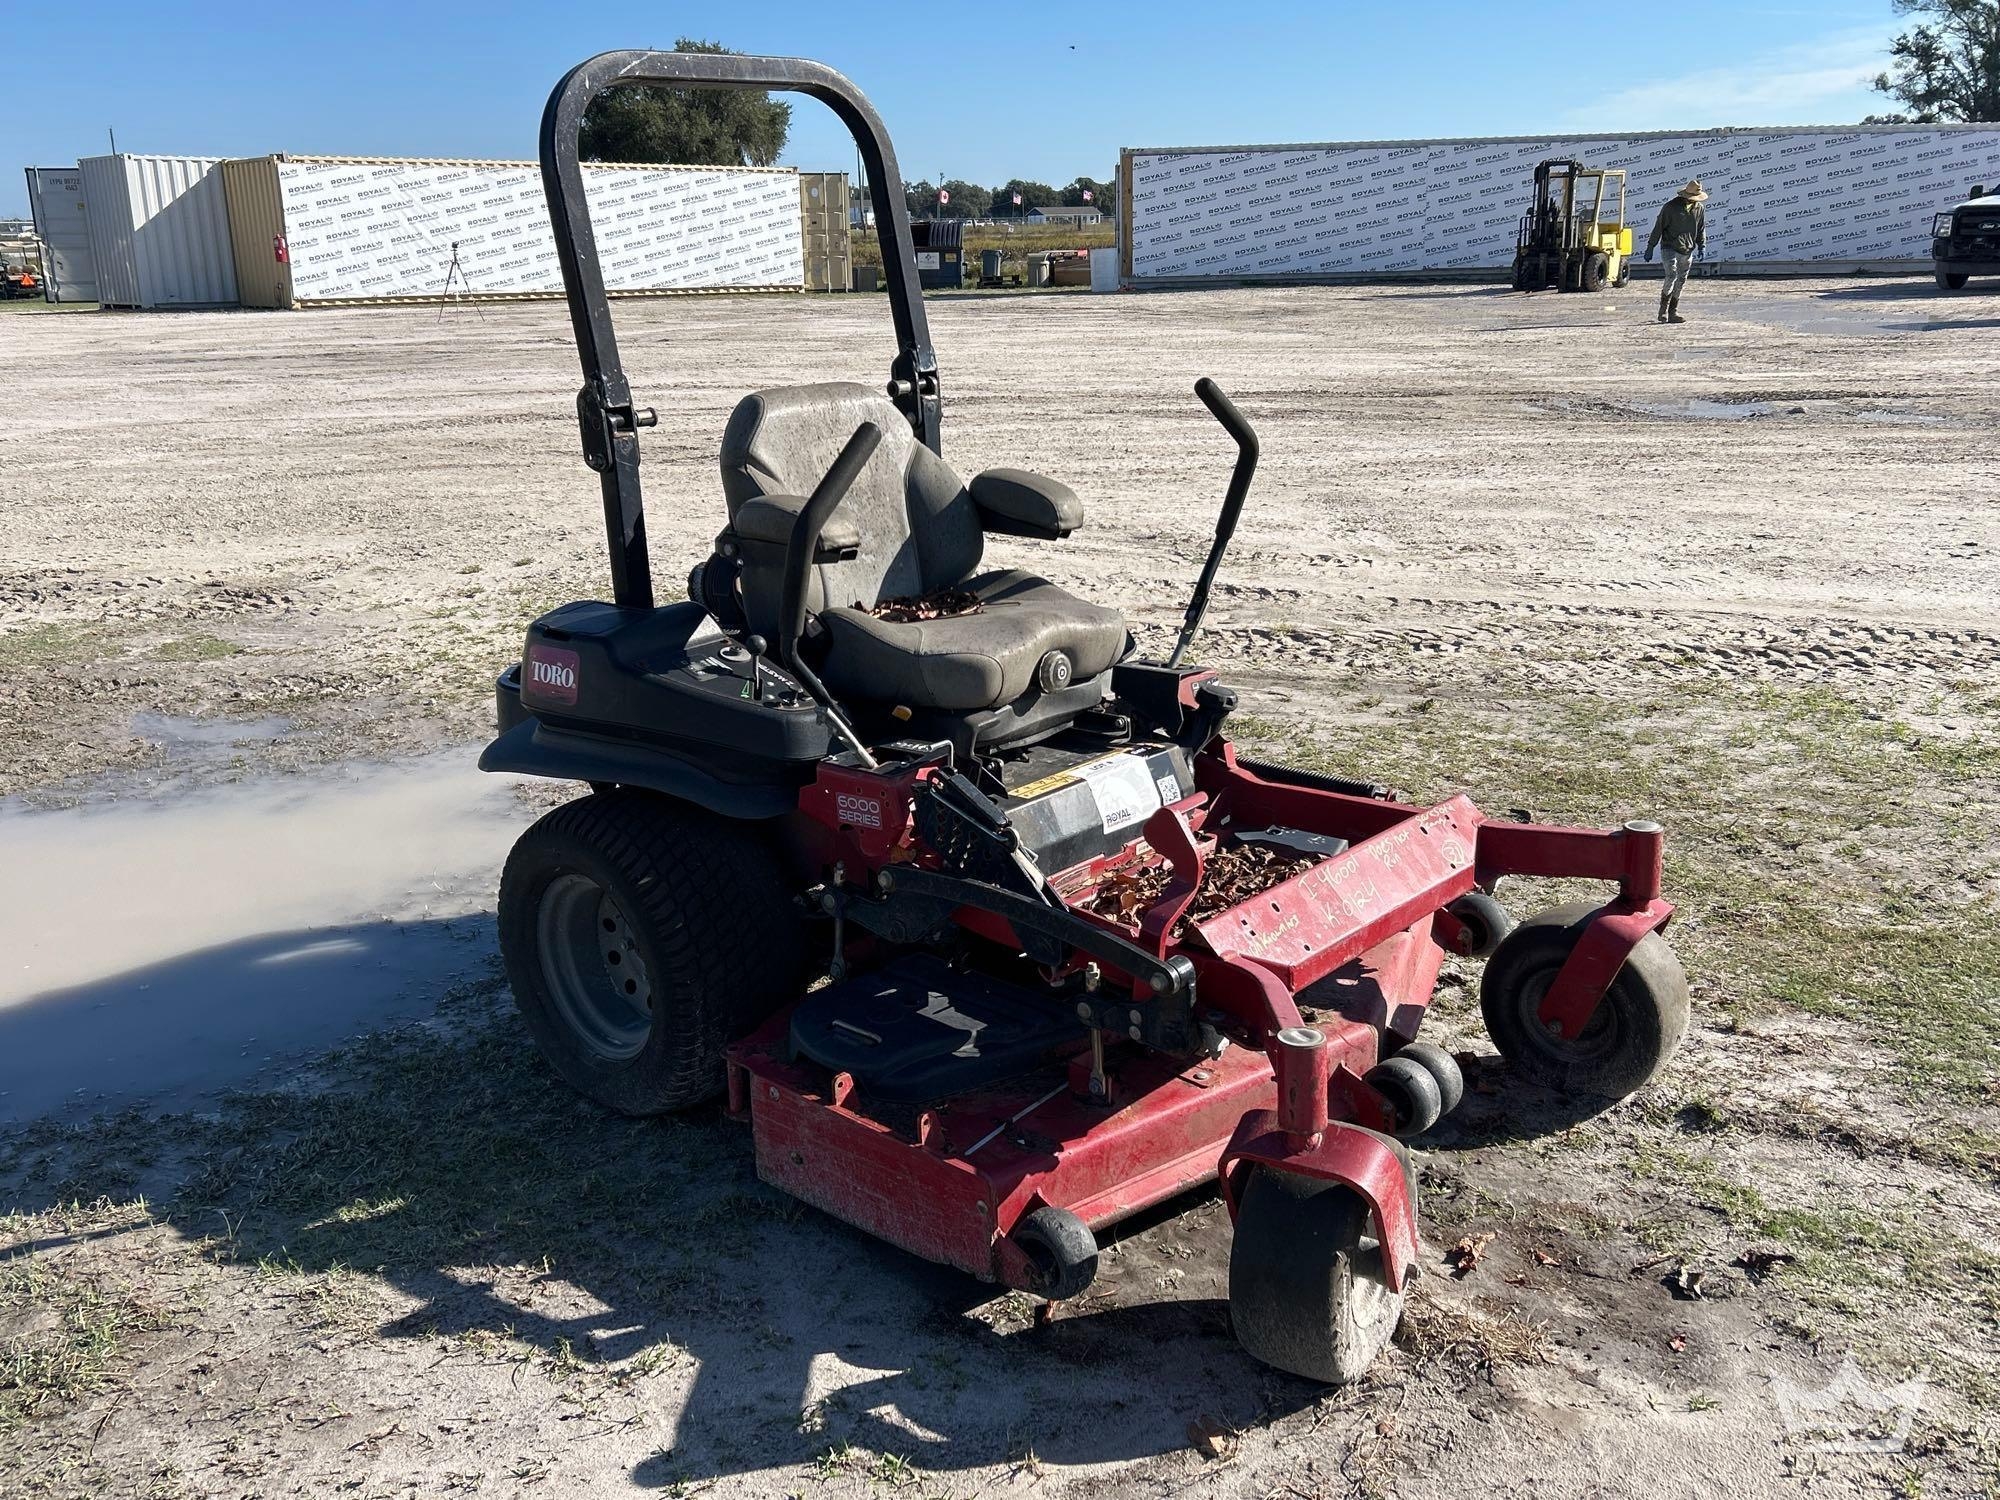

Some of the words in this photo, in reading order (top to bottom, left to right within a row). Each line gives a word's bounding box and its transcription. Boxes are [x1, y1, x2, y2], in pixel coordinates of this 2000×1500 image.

[1895, 137, 1923, 147] ROYAL
[1962, 140, 1991, 150] ROYAL
[1518, 145, 1545, 154] ROYAL
[1585, 146, 1611, 155] ROYAL
[1649, 147, 1677, 157] ROYAL
[1781, 145, 1809, 154] ROYAL
[1850, 146, 1878, 156] ROYAL
[1219, 155, 1245, 164] ROYAL
[1347, 158, 1373, 167] ROYAL
[1476, 154, 1502, 163] ROYAL
[1607, 157, 1633, 166] ROYAL
[1675, 158, 1701, 167] ROYAL
[1736, 154, 1764, 164] ROYAL
[1805, 156, 1834, 166] ROYAL
[1872, 158, 1901, 168] ROYAL
[1179, 163, 1204, 173] ROYAL
[1244, 165, 1269, 174] ROYAL
[1434, 163, 1460, 172] ROYAL
[1500, 165, 1526, 174] ROYAL
[1942, 160, 1970, 170] ROYAL
[372, 168, 397, 177] ROYAL
[1306, 167, 1332, 176] ROYAL
[1371, 168, 1397, 177] ROYAL
[1631, 168, 1658, 177] ROYAL
[1696, 169, 1724, 179] ROYAL
[1761, 165, 1789, 175] ROYAL
[1827, 167, 1855, 177] ROYAL
[1897, 169, 1925, 179] ROYAL
[331, 176, 357, 185] ROYAL
[437, 172, 462, 181] ROYAL
[1139, 173, 1164, 182] ROYAL
[1203, 174, 1229, 183] ROYAL
[1458, 173, 1484, 183] ROYAL
[1964, 172, 1992, 182] ROYAL
[398, 181, 424, 189] ROYAL
[497, 177, 520, 186] ROYAL
[743, 181, 763, 189] ROYAL
[1330, 178, 1356, 186] ROYAL
[1393, 179, 1419, 189] ROYAL
[1653, 179, 1680, 188] ROYAL
[1852, 178, 1880, 188] ROYAL
[1919, 181, 1947, 191] ROYAL
[288, 185, 316, 194] ROYAL
[460, 185, 483, 194] ROYAL
[664, 184, 685, 192] ROYAL
[713, 188, 733, 196] ROYAL
[1163, 183, 1189, 193] ROYAL
[1225, 186, 1250, 194] ROYAL
[1289, 186, 1315, 196] ROYAL
[1480, 185, 1506, 194] ROYAL
[1739, 186, 1767, 195] ROYAL
[357, 189, 384, 197] ROYAL
[421, 193, 445, 202] ROYAL
[631, 191, 652, 199] ROYAL
[1351, 189, 1378, 198] ROYAL
[1874, 190, 1903, 200] ROYAL
[316, 197, 342, 206] ROYAL
[483, 196, 507, 205] ROYAL
[598, 199, 619, 207] ROYAL
[1184, 194, 1210, 204] ROYAL
[1249, 196, 1274, 205] ROYAL
[1310, 198, 1337, 207] ROYAL
[1438, 194, 1464, 203] ROYAL
[1504, 195, 1530, 205] ROYAL
[381, 201, 407, 210] ROYAL
[650, 202, 671, 211] ROYAL
[1376, 199, 1402, 208] ROYAL
[1830, 199, 1858, 209] ROYAL
[1899, 202, 1927, 211] ROYAL
[446, 205, 470, 214] ROYAL
[504, 208, 529, 217] ROYAL
[1145, 204, 1170, 213] ROYAL
[1209, 205, 1234, 214] ROYAL
[1462, 205, 1488, 214] ROYAL
[341, 209, 367, 219] ROYAL
[407, 213, 432, 222] ROYAL
[617, 210, 638, 218] ROYAL
[1397, 210, 1423, 219] ROYAL
[1786, 209, 1813, 218] ROYAL
[299, 218, 326, 228] ROYAL
[468, 217, 492, 226] ROYAL
[719, 217, 740, 225] ROYAL
[1169, 214, 1194, 223] ROYAL
[1230, 216, 1255, 225] ROYAL
[1294, 217, 1320, 226] ROYAL
[1742, 218, 1769, 227] ROYAL
[367, 221, 394, 231] ROYAL
[638, 221, 659, 229] ROYAL
[1810, 220, 1837, 229] ROYAL
[1876, 222, 1904, 232] ROYAL
[430, 225, 455, 234] ROYAL
[491, 228, 515, 237] ROYAL
[1190, 225, 1215, 234] ROYAL
[1253, 226, 1279, 236] ROYAL
[1442, 225, 1468, 234] ROYAL
[326, 230, 353, 240] ROYAL
[391, 234, 416, 243] ROYAL
[656, 232, 677, 240] ROYAL
[1900, 233, 1929, 243] ROYAL
[513, 240, 536, 249] ROYAL
[624, 240, 645, 248] ROYAL
[1213, 236, 1239, 244] ROYAL
[1274, 237, 1300, 247] ROYAL
[1339, 239, 1365, 248] ROYAL
[1467, 236, 1493, 245] ROYAL
[350, 243, 377, 252] ROYAL
[416, 245, 442, 254] ROYAL
[773, 248, 794, 256] ROYAL
[1174, 245, 1199, 253] ROYAL
[1234, 247, 1260, 256] ROYAL
[1425, 244, 1451, 254] ROYAL
[309, 252, 336, 262] ROYAL
[476, 249, 500, 257] ROYAL
[644, 251, 666, 259] ROYAL
[1299, 248, 1324, 257] ROYAL
[1360, 250, 1387, 259] ROYAL
[377, 254, 403, 263] ROYAL
[694, 254, 715, 262] ROYAL
[499, 259, 524, 268] ROYAL
[663, 262, 684, 270] ROYAL
[336, 264, 362, 273] ROYAL
[400, 266, 426, 275] ROYAL
[294, 273, 321, 283] ROYAL
[521, 271, 544, 280] ROYAL
[631, 270, 652, 278] ROYAL
[360, 275, 386, 285] ROYAL
[319, 285, 345, 295] ROYAL
[531, 661, 574, 688] TORO
[838, 795, 880, 813] 6000
[839, 809, 881, 827] SERIES
[1105, 808, 1131, 824] ROYAL
